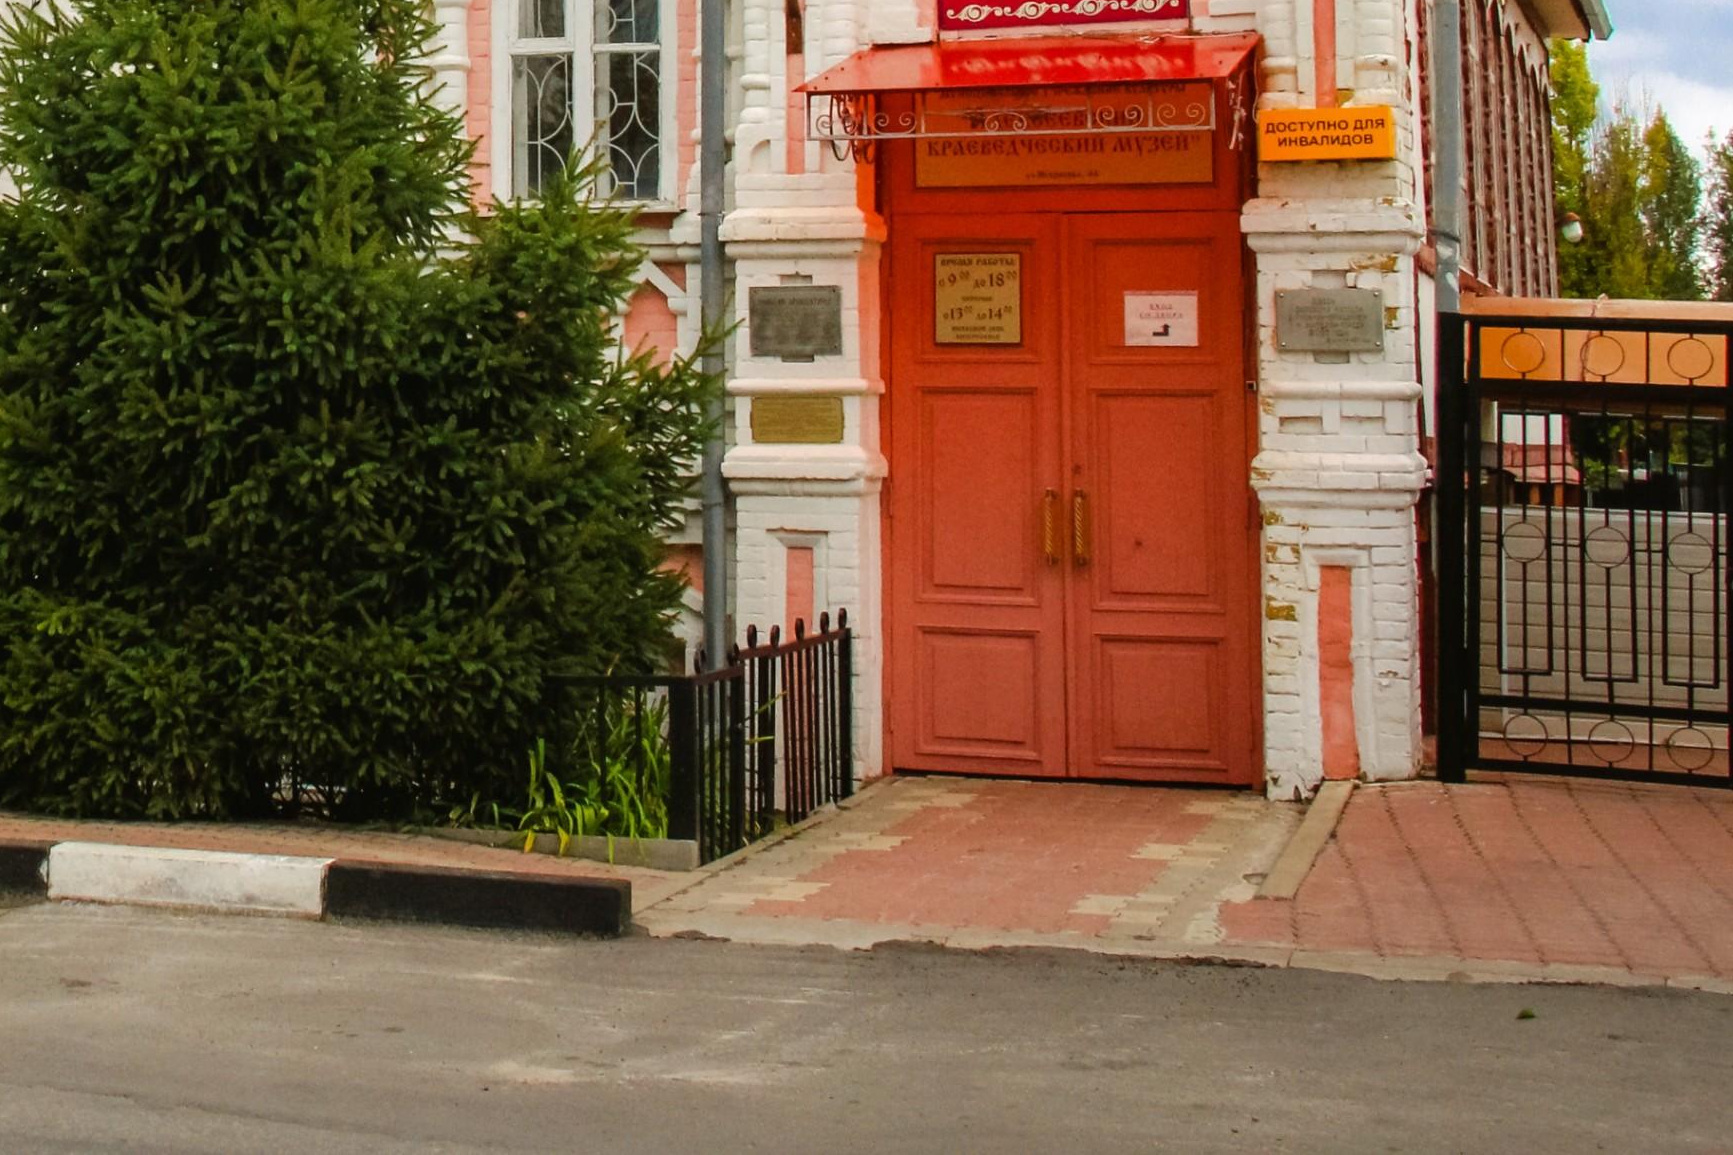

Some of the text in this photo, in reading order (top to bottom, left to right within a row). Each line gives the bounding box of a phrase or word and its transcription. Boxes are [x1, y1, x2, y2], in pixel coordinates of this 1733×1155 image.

[1265, 118, 1385, 134] ДОСТУПНО ДЛЯ
[1278, 134, 1373, 147] ИНВАЛИДОВ
